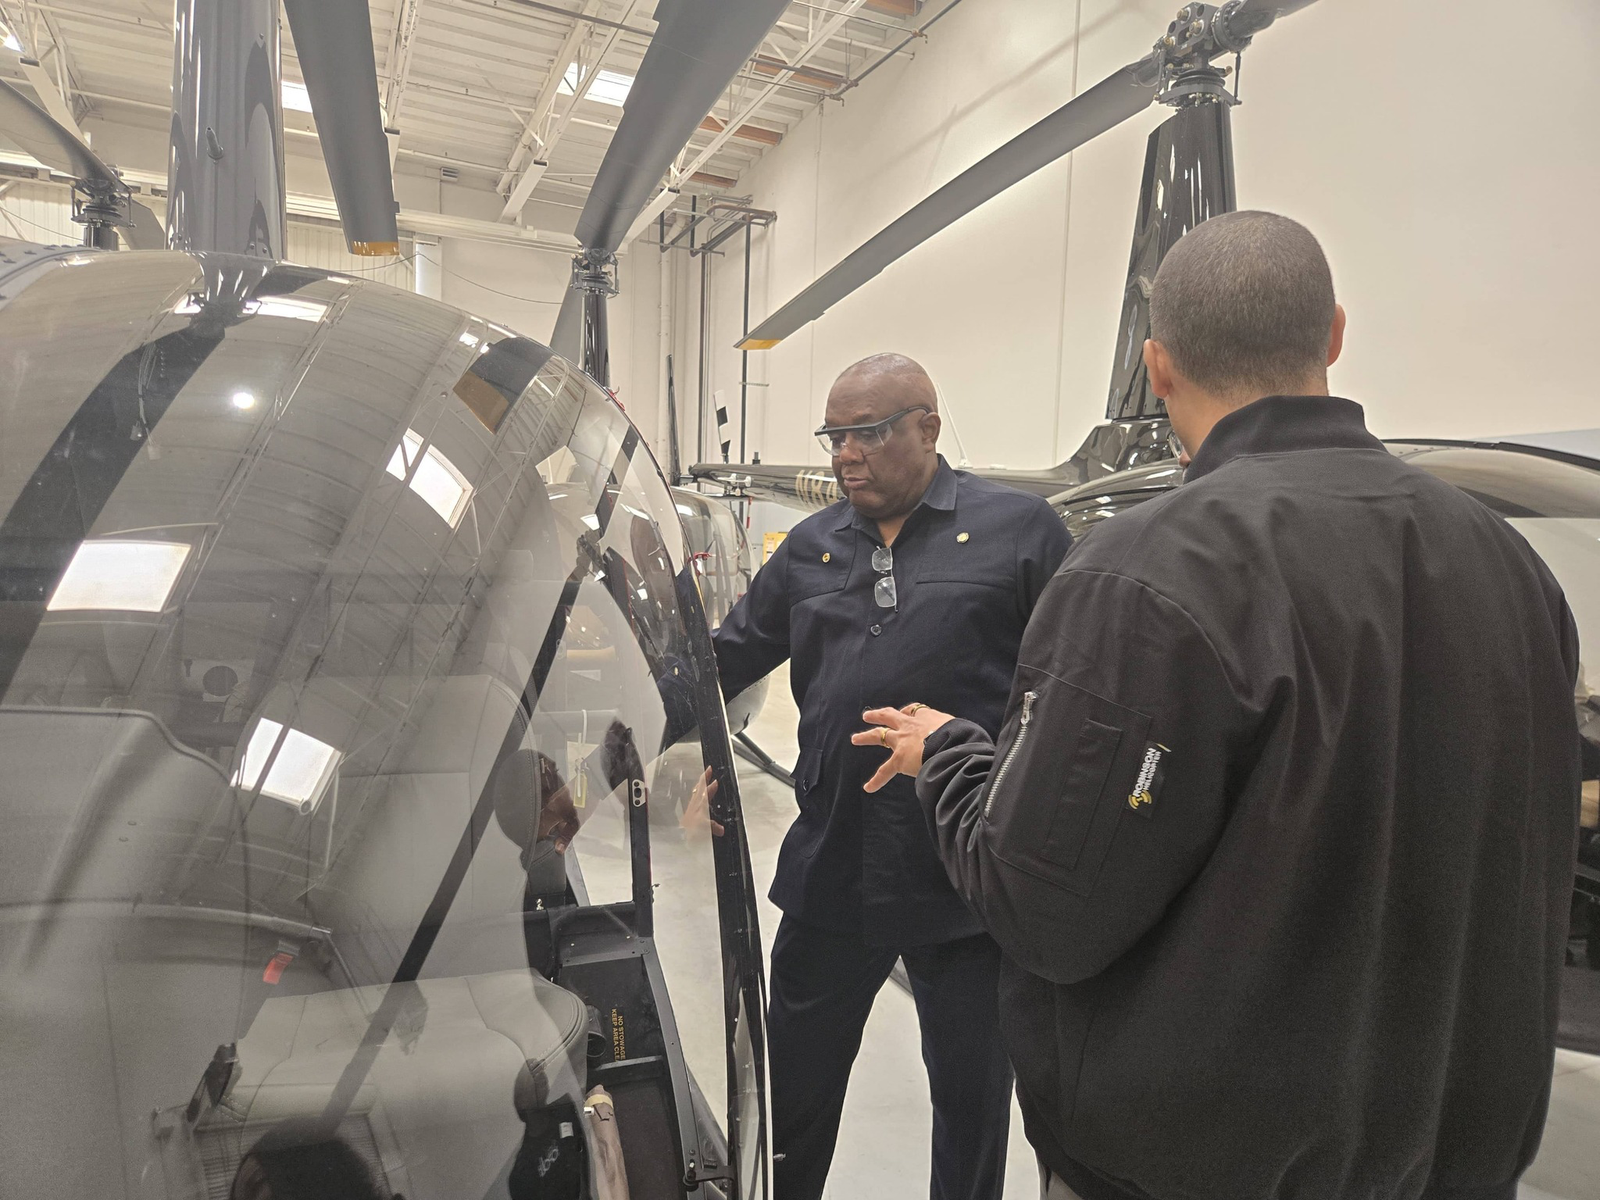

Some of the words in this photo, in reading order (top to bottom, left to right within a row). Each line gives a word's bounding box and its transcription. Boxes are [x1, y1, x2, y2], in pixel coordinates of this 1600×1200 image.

[1132, 747, 1157, 797] ROBINSON
[1142, 751, 1162, 791] HELICOPTER
[617, 1015, 624, 1026] NO
[618, 1026, 626, 1060] STOWAGE
